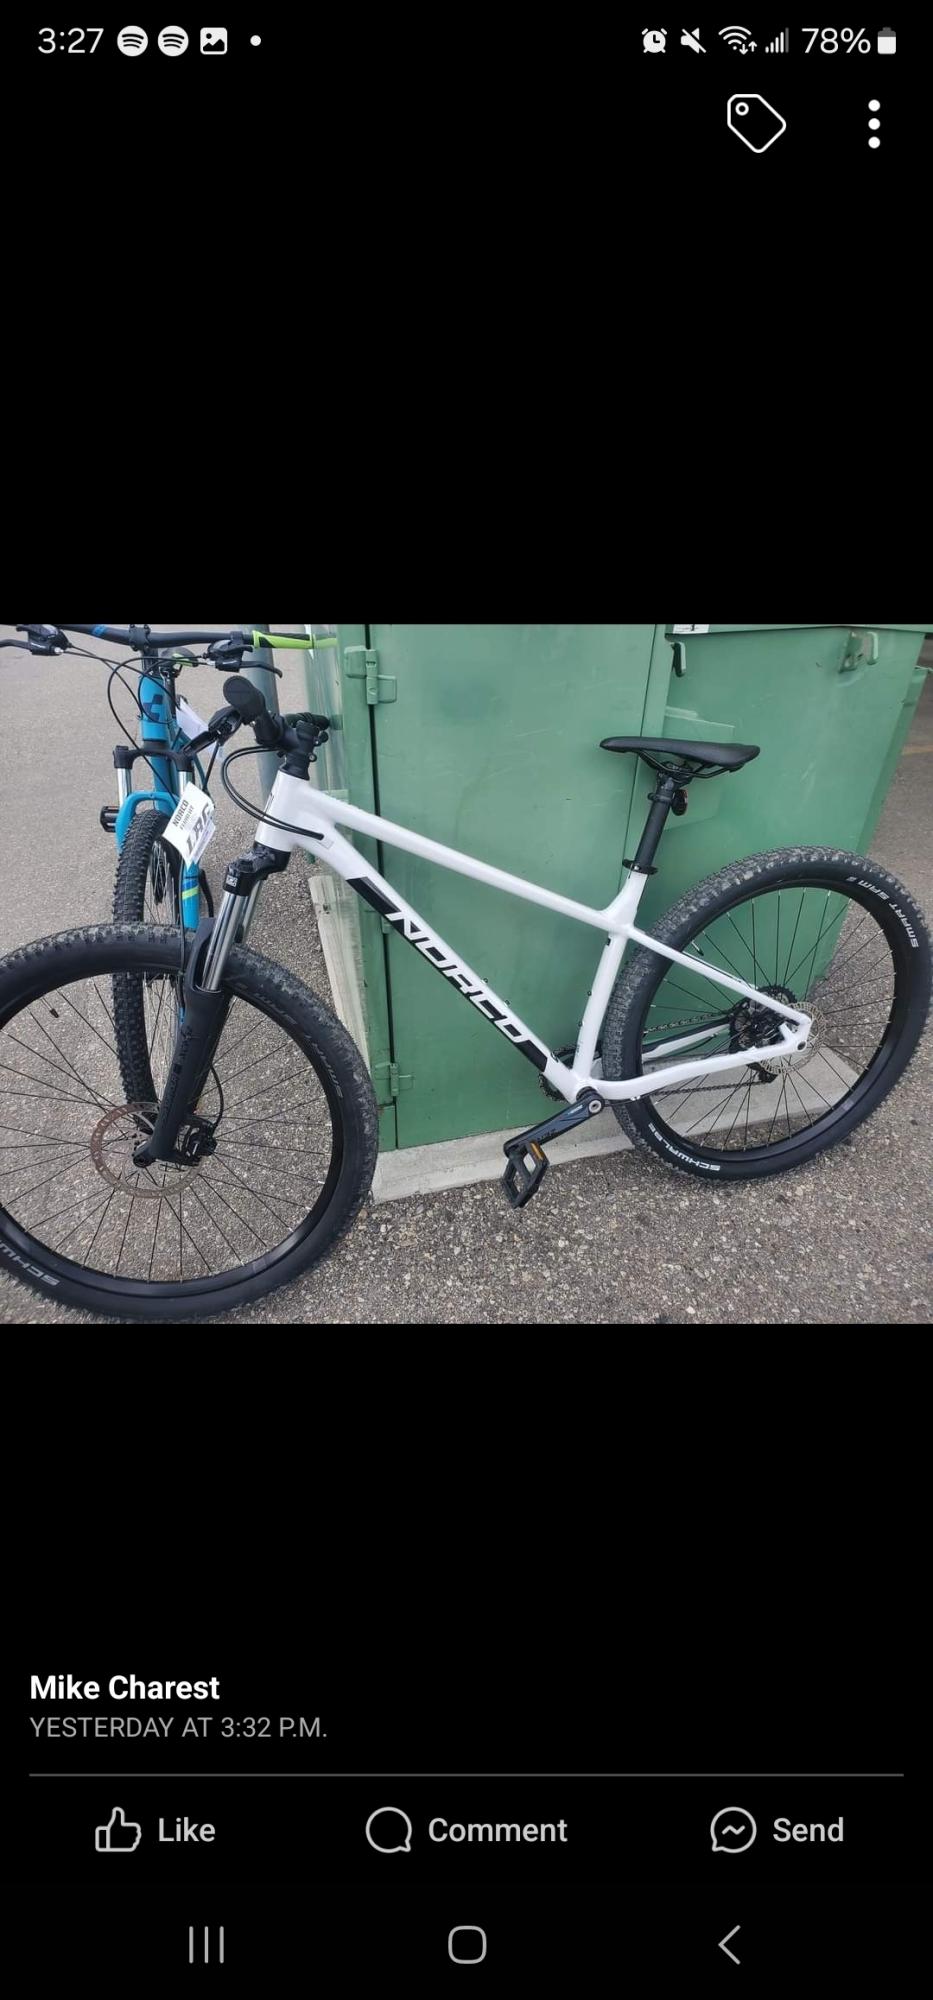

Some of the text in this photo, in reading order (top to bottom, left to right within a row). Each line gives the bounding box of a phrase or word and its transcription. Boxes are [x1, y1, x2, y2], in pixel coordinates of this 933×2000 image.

[172, 799, 189, 828] NORCO
[857, 879, 919, 948] SMART SAM
[385, 911, 532, 1044] NORCO
[648, 1122, 721, 1172] SCHWALBE
